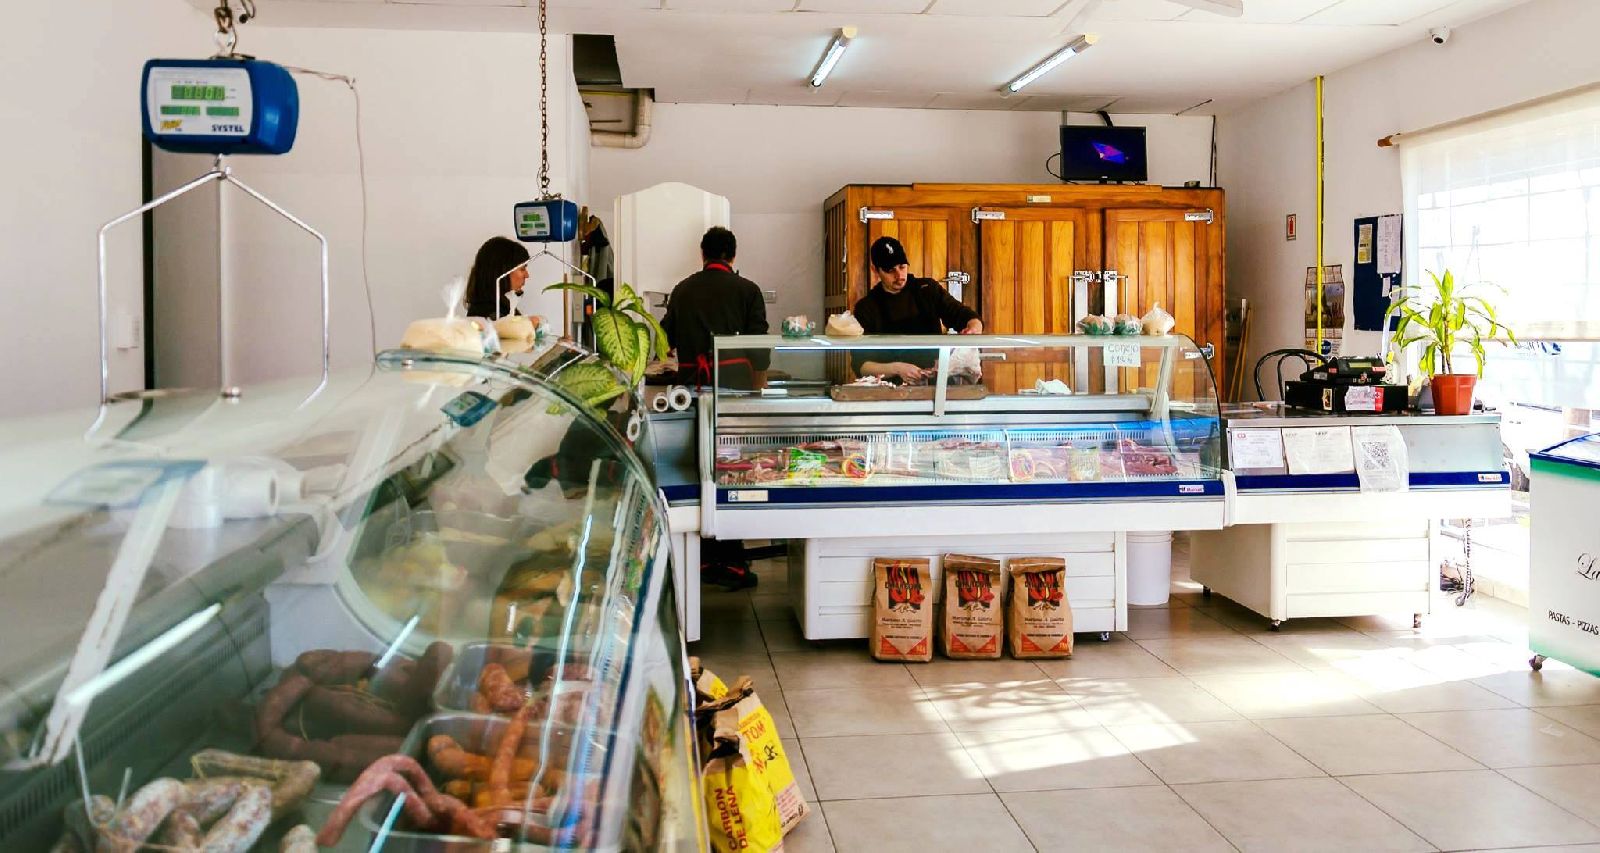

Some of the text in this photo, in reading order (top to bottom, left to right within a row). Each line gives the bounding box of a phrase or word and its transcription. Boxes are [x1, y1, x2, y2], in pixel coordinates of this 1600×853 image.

[211, 123, 244, 133] SYSTEL
[1548, 610, 1570, 625] PASTAS
[715, 788, 737, 850] CARBON
[736, 827, 749, 849] DE
